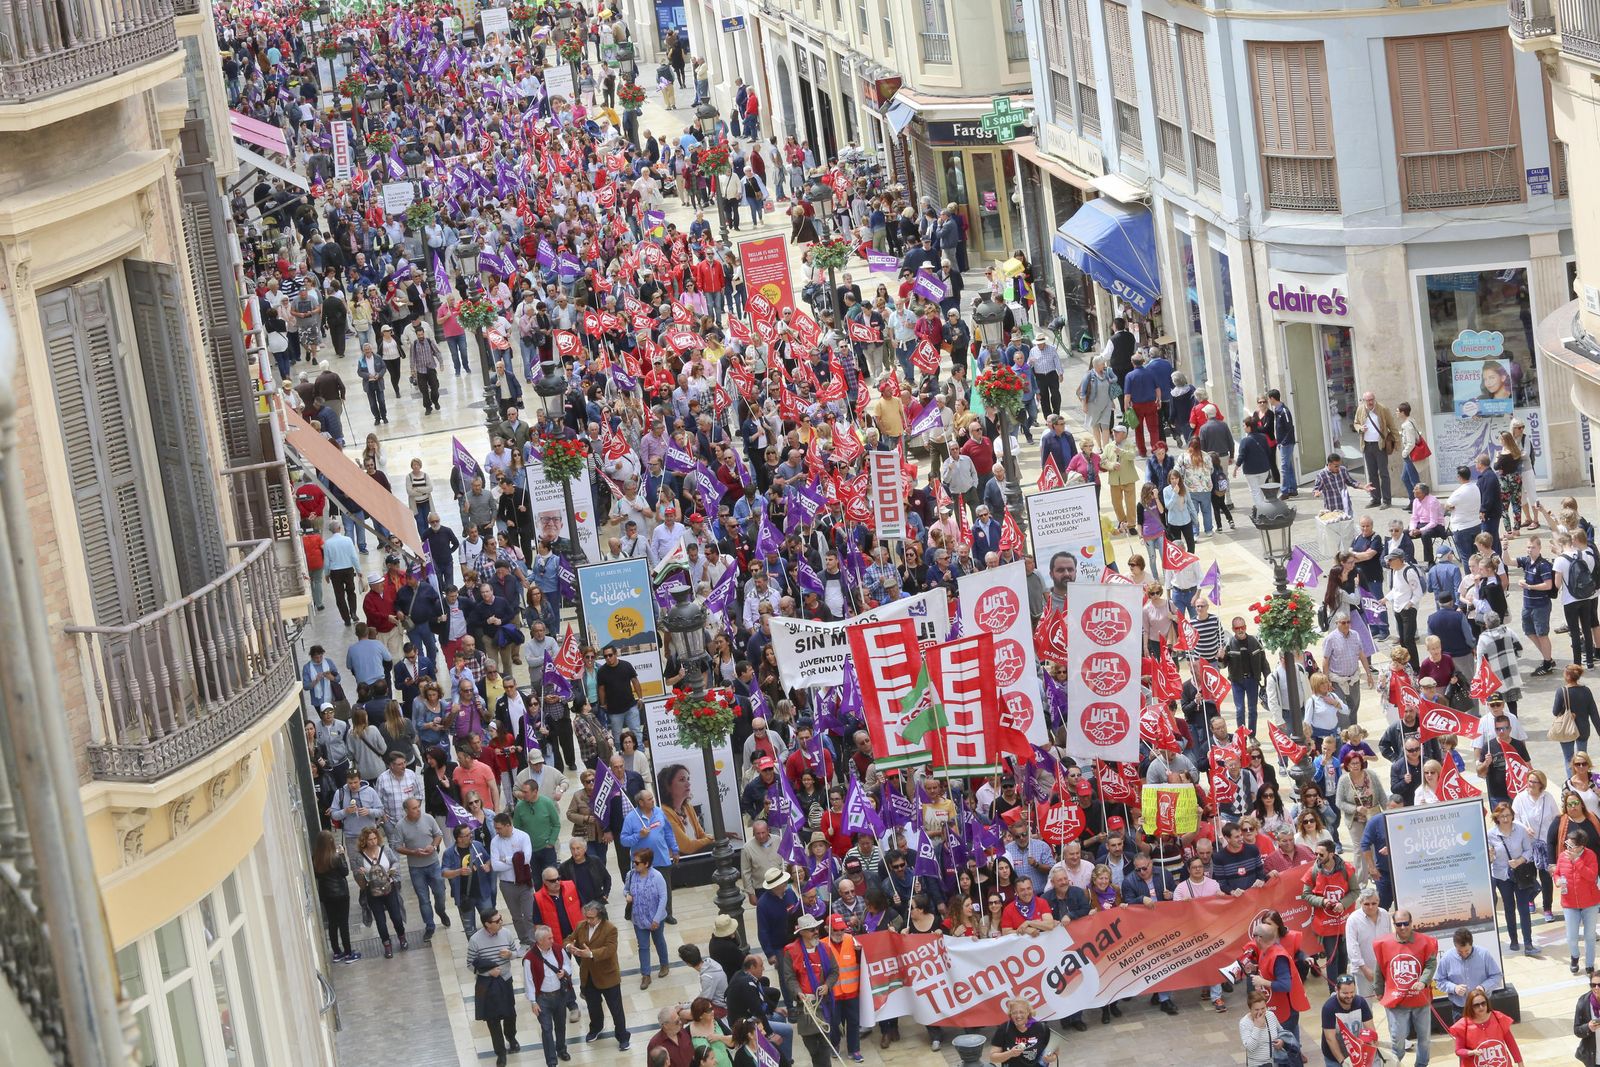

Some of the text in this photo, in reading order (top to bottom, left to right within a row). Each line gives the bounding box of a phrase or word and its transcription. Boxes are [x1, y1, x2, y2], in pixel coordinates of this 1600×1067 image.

[926, 282, 943, 296] CCOO
[1111, 279, 1146, 308] SUR
[1268, 283, 1347, 316] claire's
[1454, 374, 1481, 382] GRATIS
[1526, 412, 1542, 458] claire's
[458, 450, 476, 470] CCOO
[534, 488, 557, 496] ESTIGMA
[876, 454, 900, 522] CCOO
[1046, 505, 1082, 516] AUTOESTIMA
[1049, 514, 1070, 522] EMPLEO
[1037, 522, 1054, 530] CLAVE
[1071, 516, 1091, 524] EVITAR
[600, 581, 630, 592] FESTIVAL
[982, 590, 1009, 609] UGT
[1091, 608, 1120, 622] UGT
[795, 634, 825, 654] SIN
[799, 654, 843, 669] JUVENTUD
[1092, 658, 1119, 672] UGT
[801, 668, 816, 679] POR
[818, 664, 838, 674] UNA
[940, 640, 986, 764] CCOO
[1007, 697, 1022, 713] GT
[1092, 708, 1118, 722] UGT
[1427, 712, 1458, 731] UGT
[1102, 768, 1125, 788] UGT
[1046, 805, 1078, 822] UGT
[1417, 824, 1456, 836] FESTIVAL
[1280, 904, 1308, 918] ndalucía
[1046, 917, 1121, 994] ganar
[1107, 932, 1145, 962] Igualdad
[1119, 930, 1181, 969] Mejor empleo
[1131, 931, 1209, 976] Mayores salarios
[1144, 938, 1226, 984] Pensiones dignas
[1393, 960, 1417, 974] UGT
[916, 945, 1045, 1014] Tiempo
